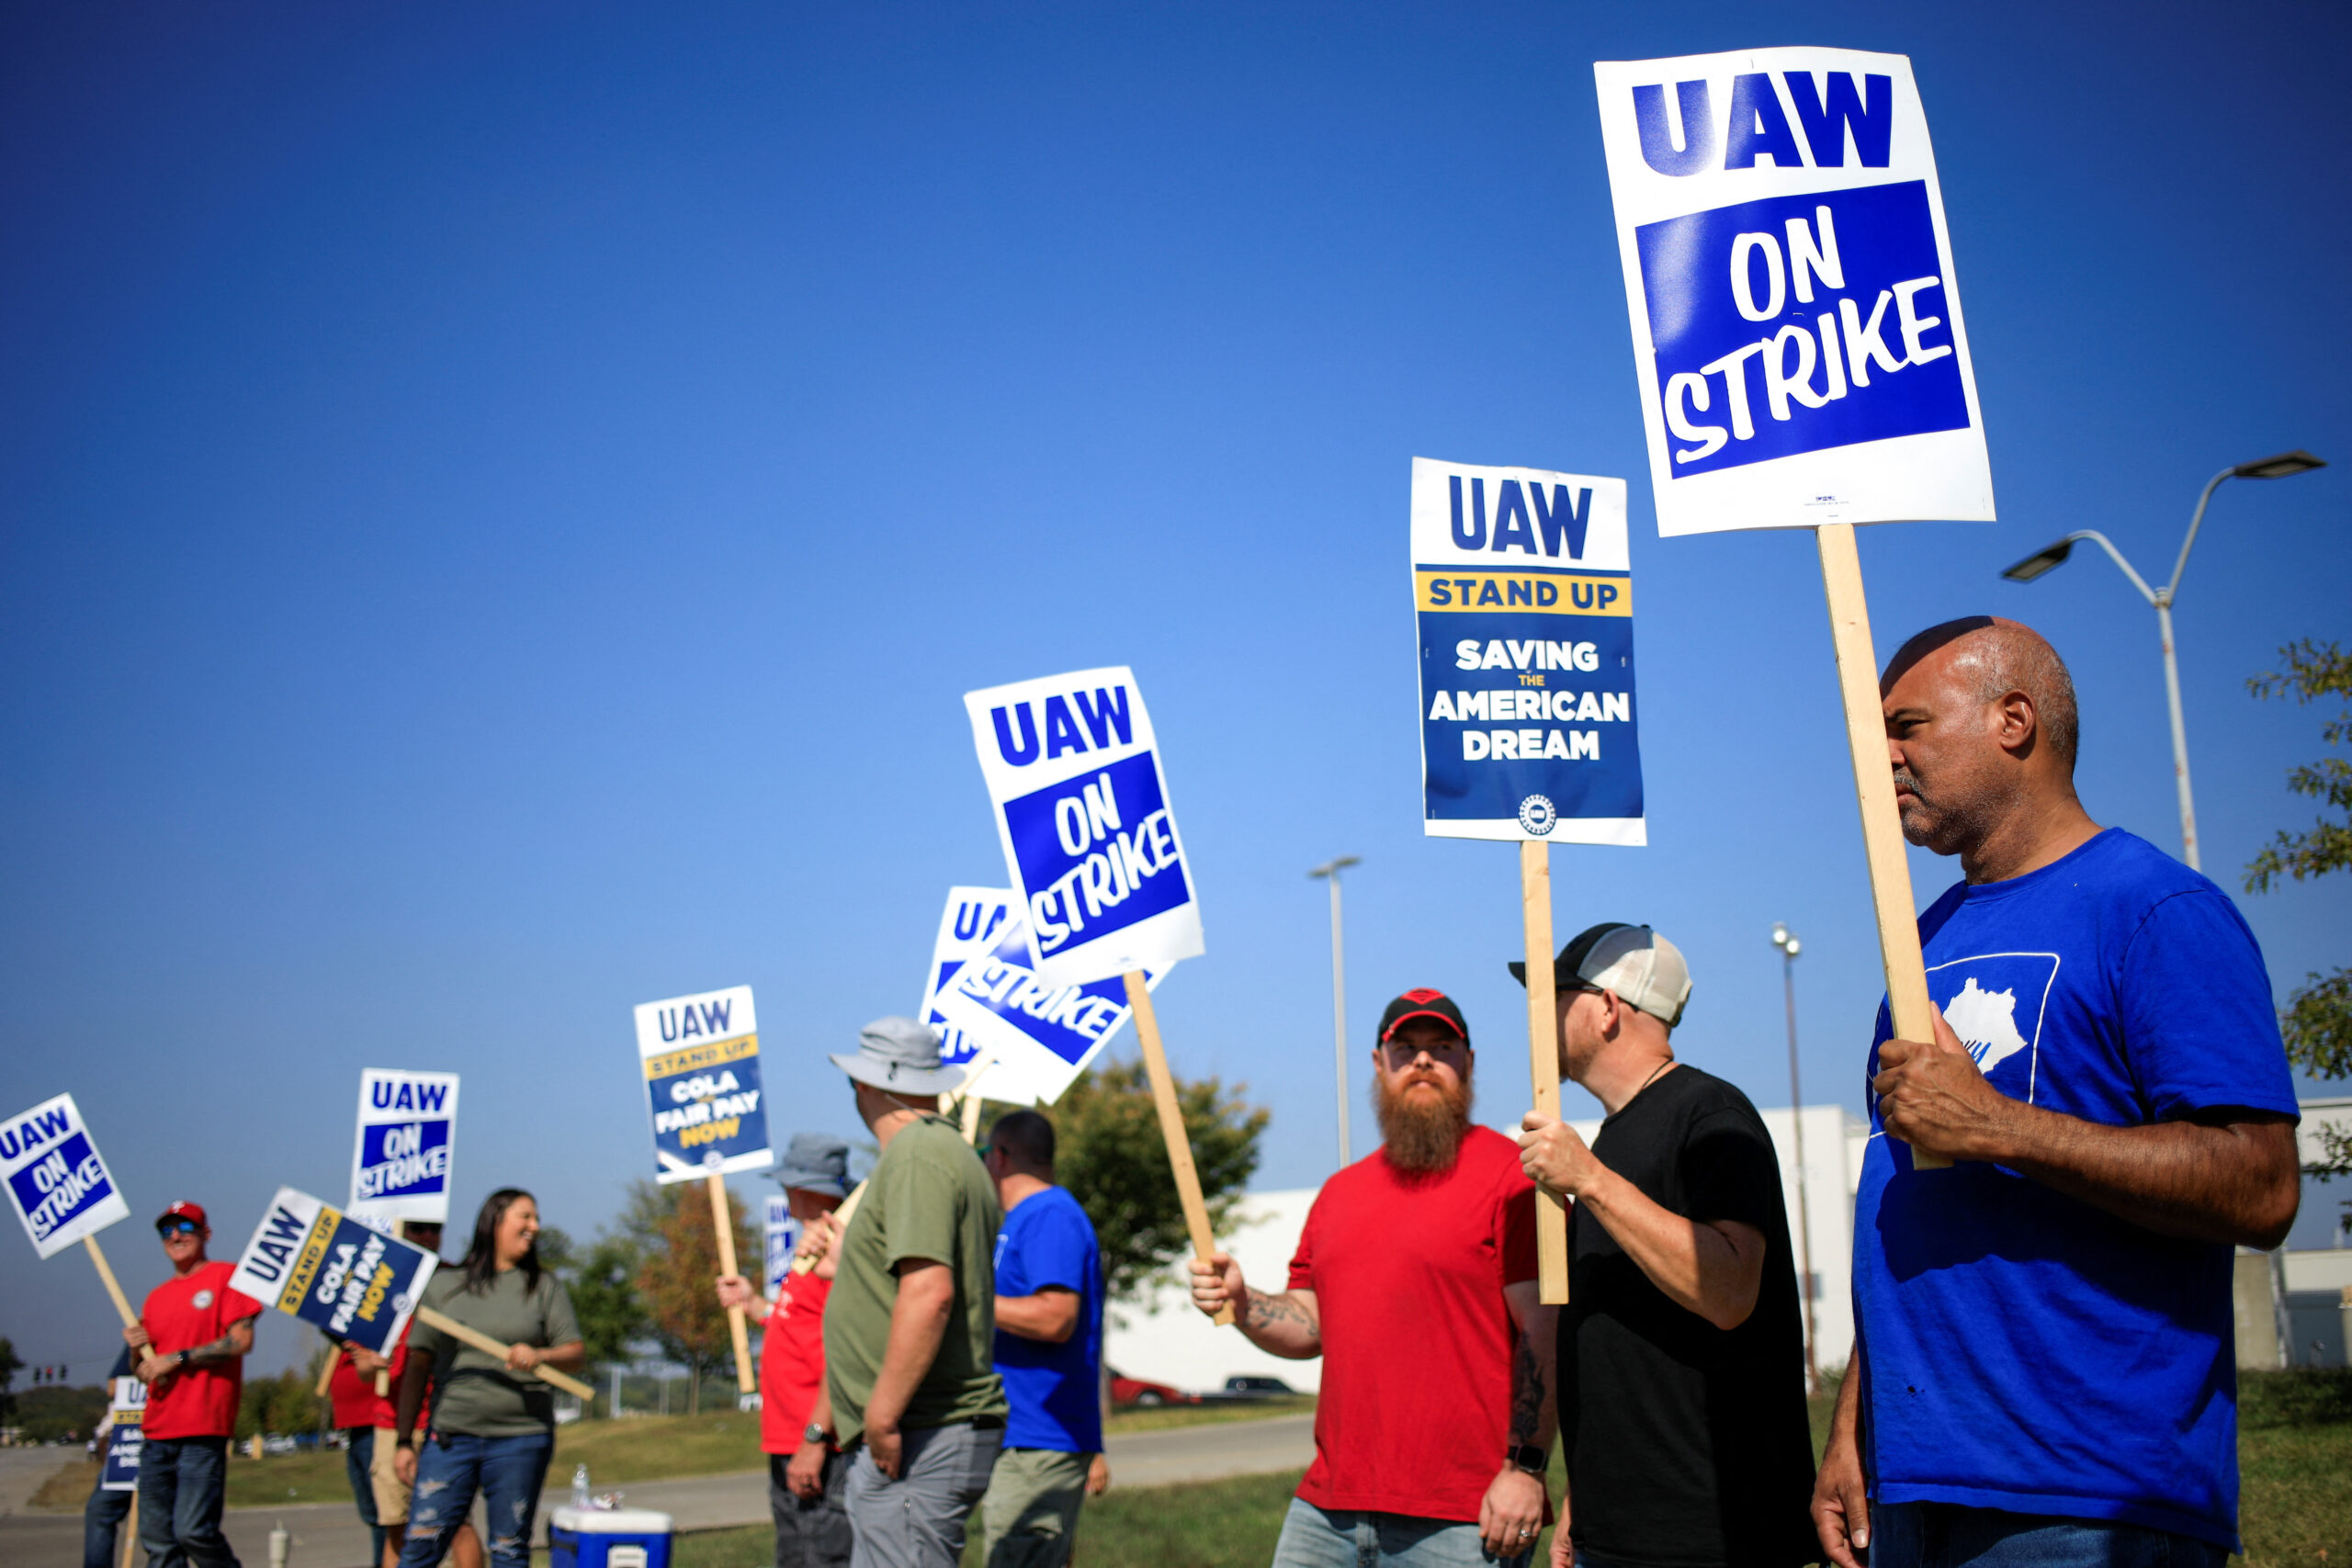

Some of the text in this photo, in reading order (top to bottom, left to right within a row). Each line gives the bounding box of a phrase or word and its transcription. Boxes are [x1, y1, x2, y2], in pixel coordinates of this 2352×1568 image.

[1632, 71, 1893, 177] UAW
[1730, 205, 1845, 322] ON
[1664, 276, 1952, 465] STRIKE
[1448, 475, 1593, 560] UAW
[1429, 579, 1619, 610] STAND UP
[1455, 639, 1600, 672] SAVING
[1518, 674, 1545, 687] THE
[990, 685, 1133, 767] UAW
[1429, 690, 1630, 722] AMERICAN
[1463, 729, 1600, 761] DREAM
[1055, 772, 1122, 857] ON
[1030, 808, 1179, 953] STRIKE
[954, 902, 1007, 942] UA
[659, 998, 731, 1042] UAW
[961, 956, 1125, 1040] STRIKE
[653, 1041, 750, 1073] STAND UP
[372, 1081, 447, 1111] UAW
[655, 1089, 761, 1134] FAIR PAY
[671, 1070, 740, 1102] COLA
[0, 1105, 70, 1160] UAW
[383, 1122, 423, 1160] ON
[679, 1116, 741, 1148] NOW
[28, 1153, 106, 1239] STRIKE
[32, 1148, 70, 1194] ON
[359, 1145, 447, 1199] STRIKE
[245, 1206, 306, 1282] UAW
[285, 1216, 333, 1306] STAND UP
[316, 1244, 358, 1304] COLA
[329, 1276, 368, 1334] FAIR
[353, 1232, 387, 1281] PAY
[356, 1261, 395, 1322] NOW
